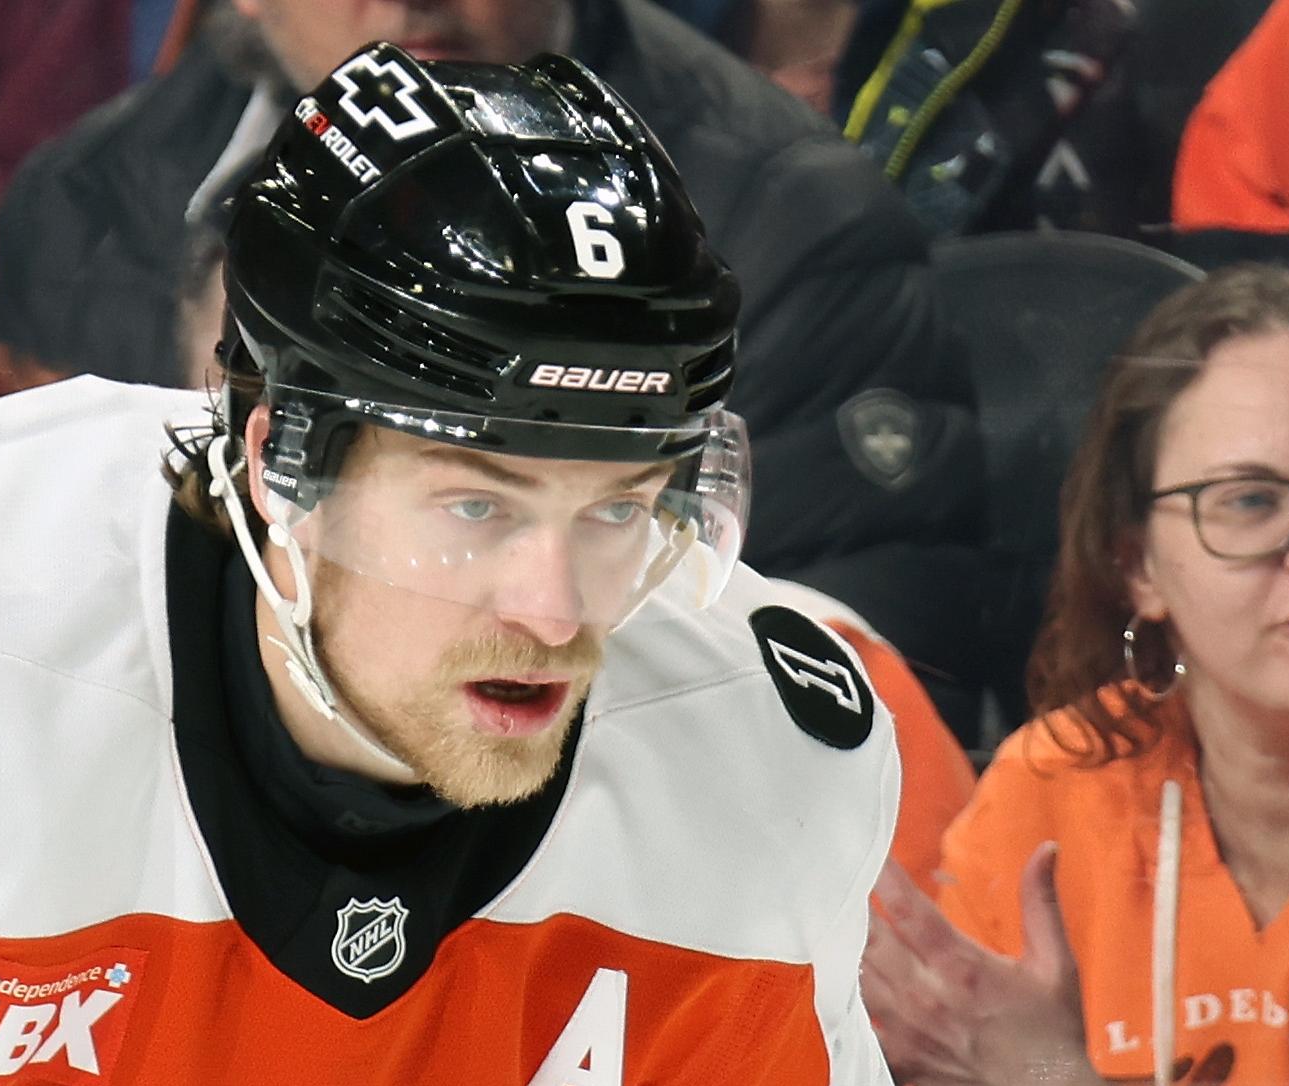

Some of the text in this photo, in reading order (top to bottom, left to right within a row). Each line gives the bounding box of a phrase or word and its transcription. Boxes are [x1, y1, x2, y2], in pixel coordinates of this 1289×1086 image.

[294, 97, 381, 184] CHEVROLET
[566, 201, 625, 279] 6
[349, 918, 393, 961] NHL
